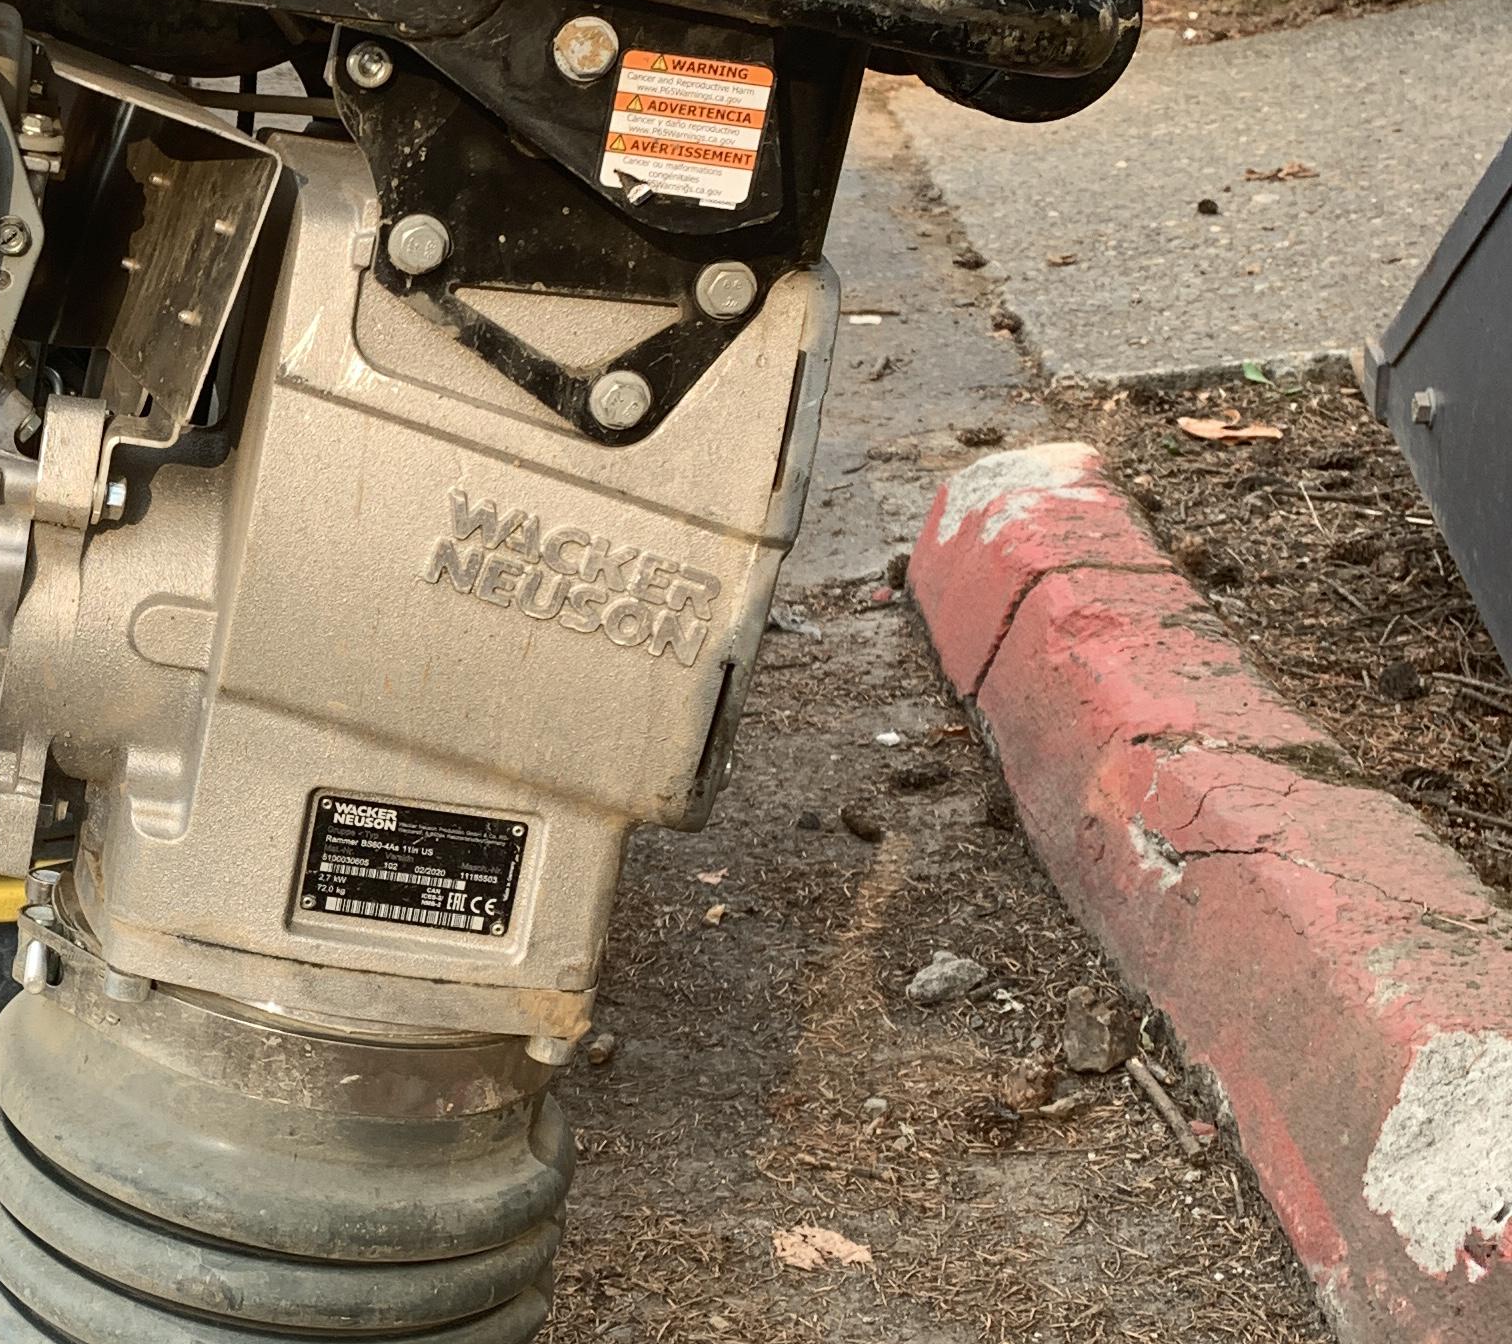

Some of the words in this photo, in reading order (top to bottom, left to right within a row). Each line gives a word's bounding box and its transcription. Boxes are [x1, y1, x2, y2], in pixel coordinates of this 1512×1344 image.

[672, 58, 749, 80] WARNING
[627, 71, 656, 82] Cancer
[657, 75, 674, 85] and
[676, 78, 730, 94] Reproductive
[732, 85, 755, 96] Harm
[647, 100, 752, 124] ADVERTENCIA
[689, 123, 741, 136] reproductivo
[630, 140, 753, 165] AVERTISSEMENT
[622, 156, 651, 167] Cancer
[666, 161, 723, 177] malformations
[448, 487, 722, 620] WACKER
[423, 537, 708, 666] NEUSON
[334, 802, 398, 820] WACKER
[332, 813, 396, 831] NEUSON
[325, 835, 358, 845] Rammer
[421, 847, 433, 856] US
[333, 875, 346, 883] kW
[414, 866, 445, 876] 02/2020
[335, 886, 346, 895] kg
